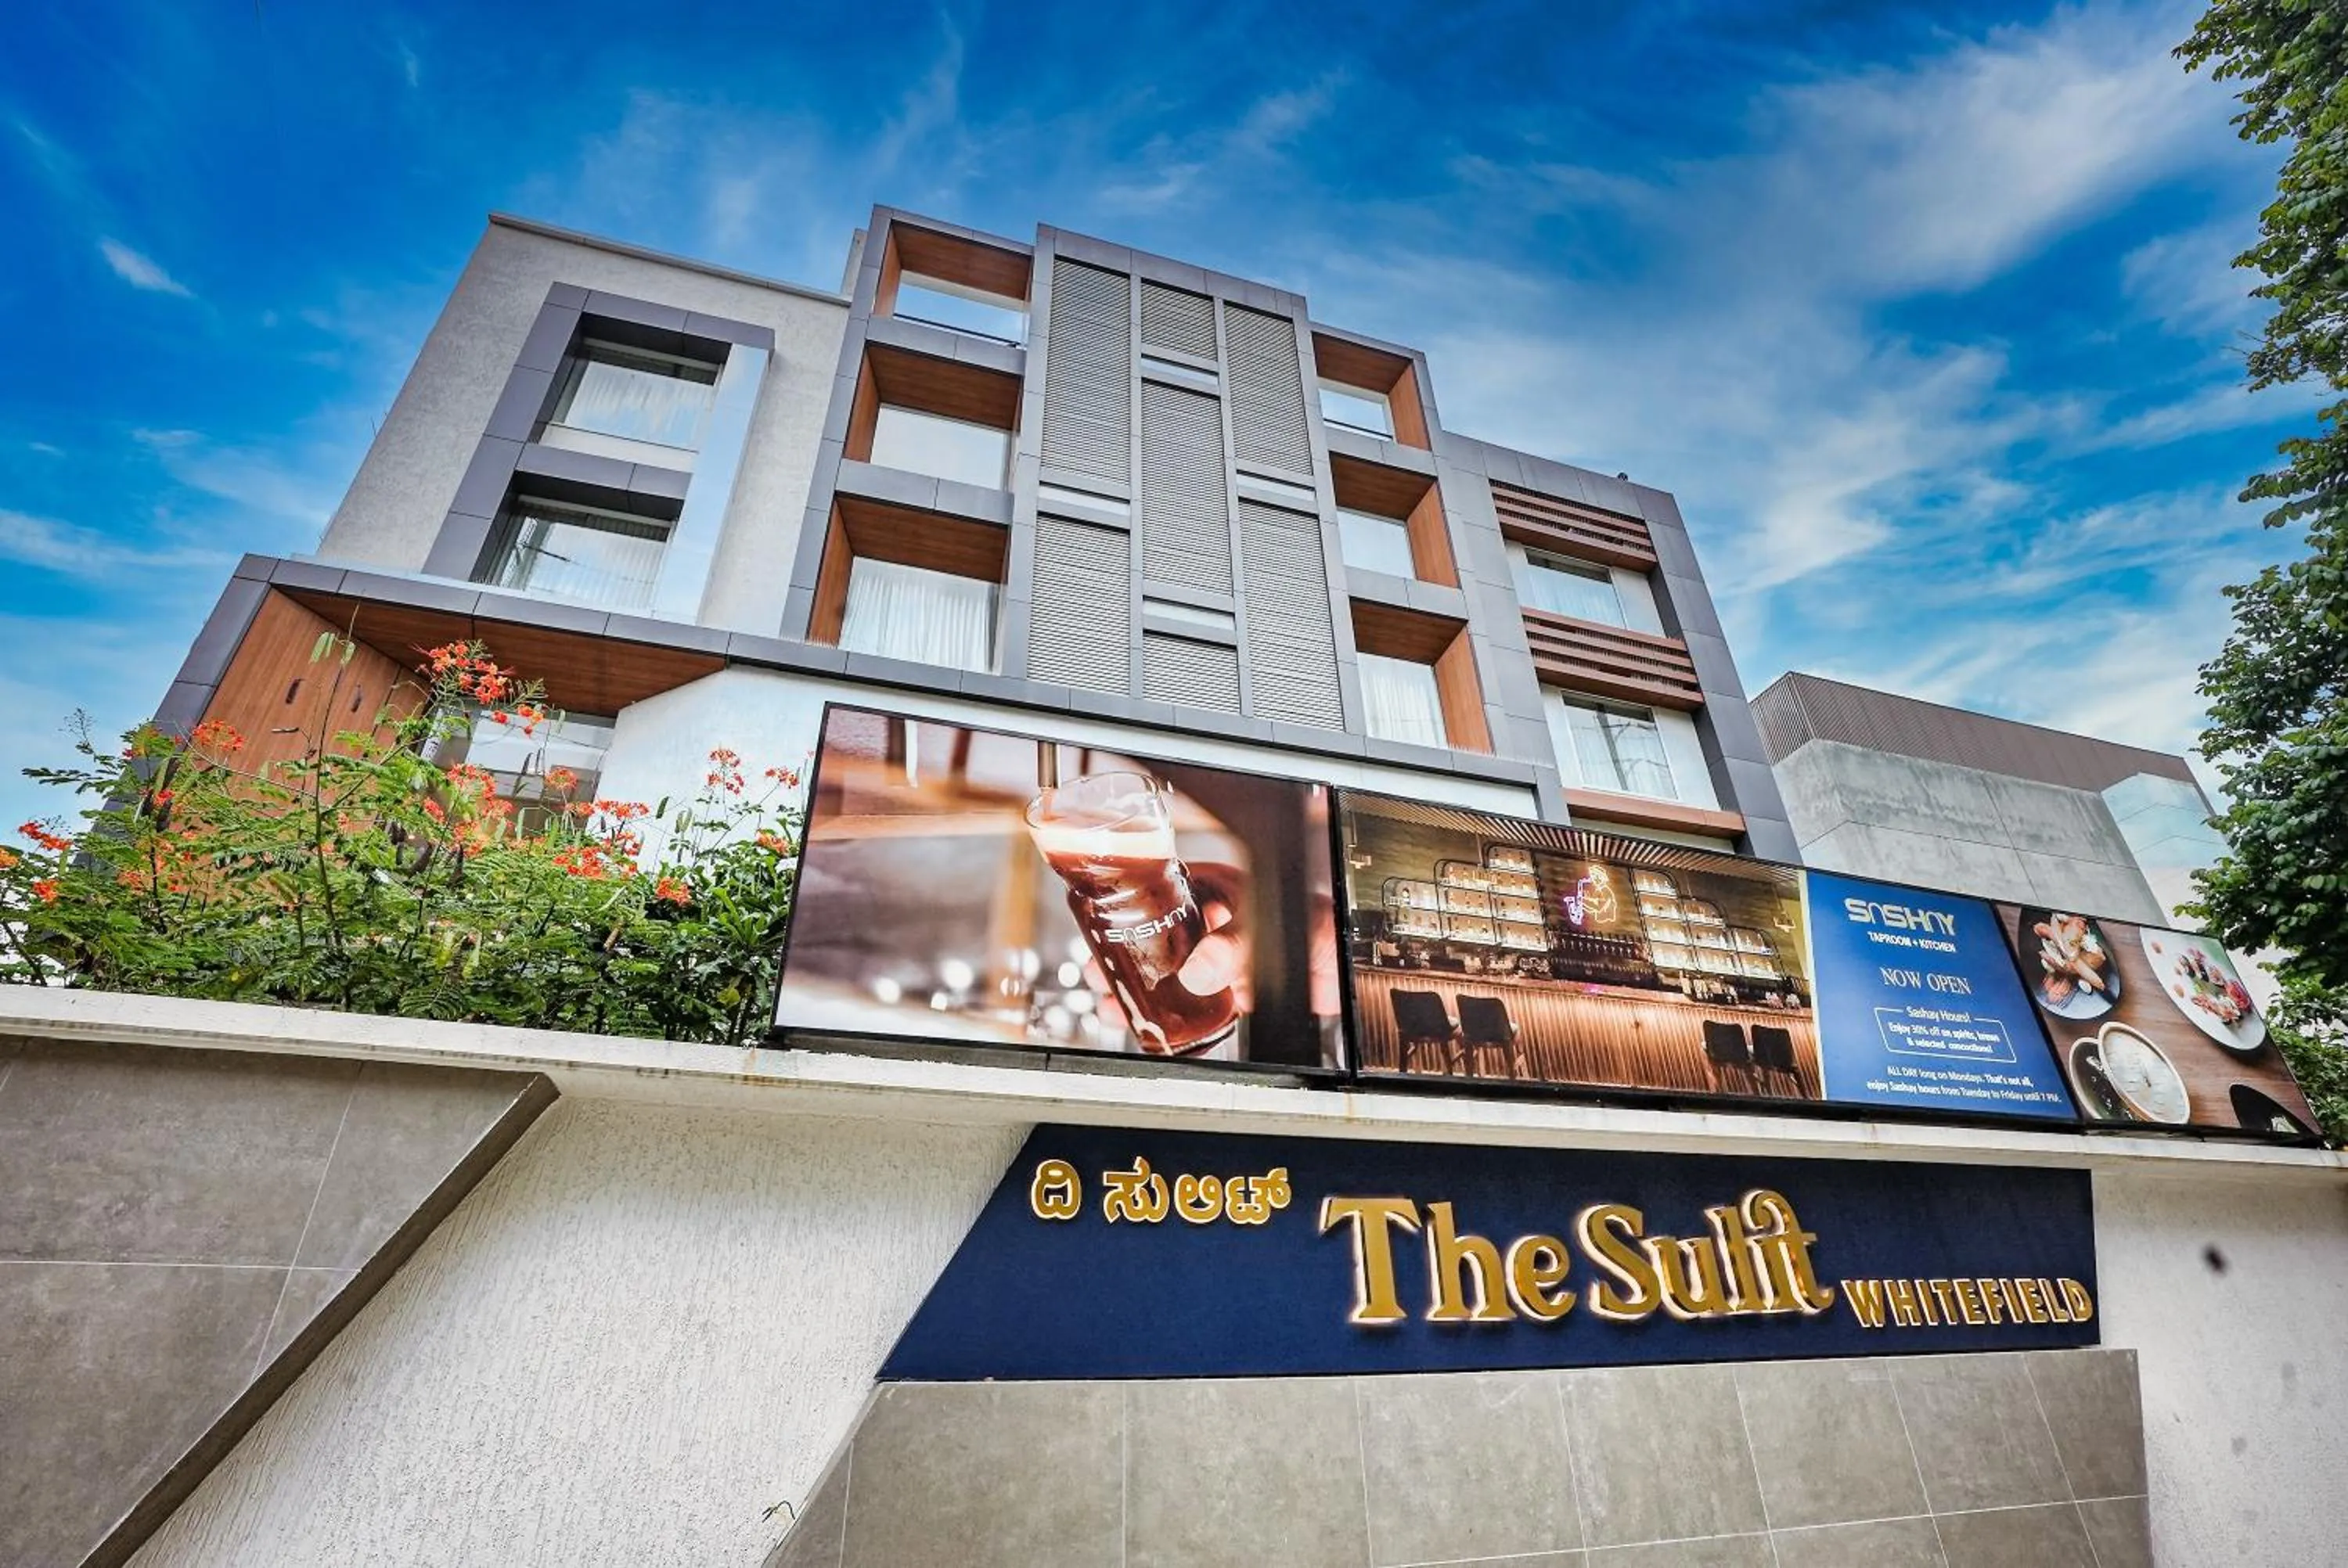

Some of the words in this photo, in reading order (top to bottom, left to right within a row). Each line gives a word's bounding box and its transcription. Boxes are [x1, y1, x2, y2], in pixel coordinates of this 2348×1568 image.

[1844, 898, 1955, 936] SASHAY
[1867, 931, 1912, 948] TAPROOM
[1918, 939, 1956, 952] KITCHEN
[1879, 966, 1921, 989] NOW
[1926, 973, 1972, 995] OPEN
[1906, 1006, 1939, 1022] Sashay
[1888, 1022, 1911, 1035] Enjoy
[1929, 1026, 1940, 1037] off
[1915, 1038, 1946, 1049] selected
[1887, 1065, 1902, 1076] ALL
[1902, 1066, 1918, 1077] DAY
[1918, 1069, 1937, 1081] long
[1985, 1074, 2008, 1084] That's
[2008, 1076, 2022, 1085] not
[1867, 1080, 1889, 1092] enjoy
[1889, 1081, 1918, 1094] Sashay
[1918, 1083, 1940, 1095] hours
[1940, 1084, 1960, 1095] from
[1960, 1087, 1990, 1099] Tuesday
[1990, 1090, 2000, 1099] to
[2000, 1090, 2023, 1102] Friday
[1031, 1159, 1082, 1220] ದಿ
[1102, 1156, 1292, 1225] ಸುಲಿಟ್
[1318, 1196, 1578, 1323] The
[1572, 1189, 1835, 1322] Sulit
[1841, 1278, 2094, 1328] WHITEFIELD
